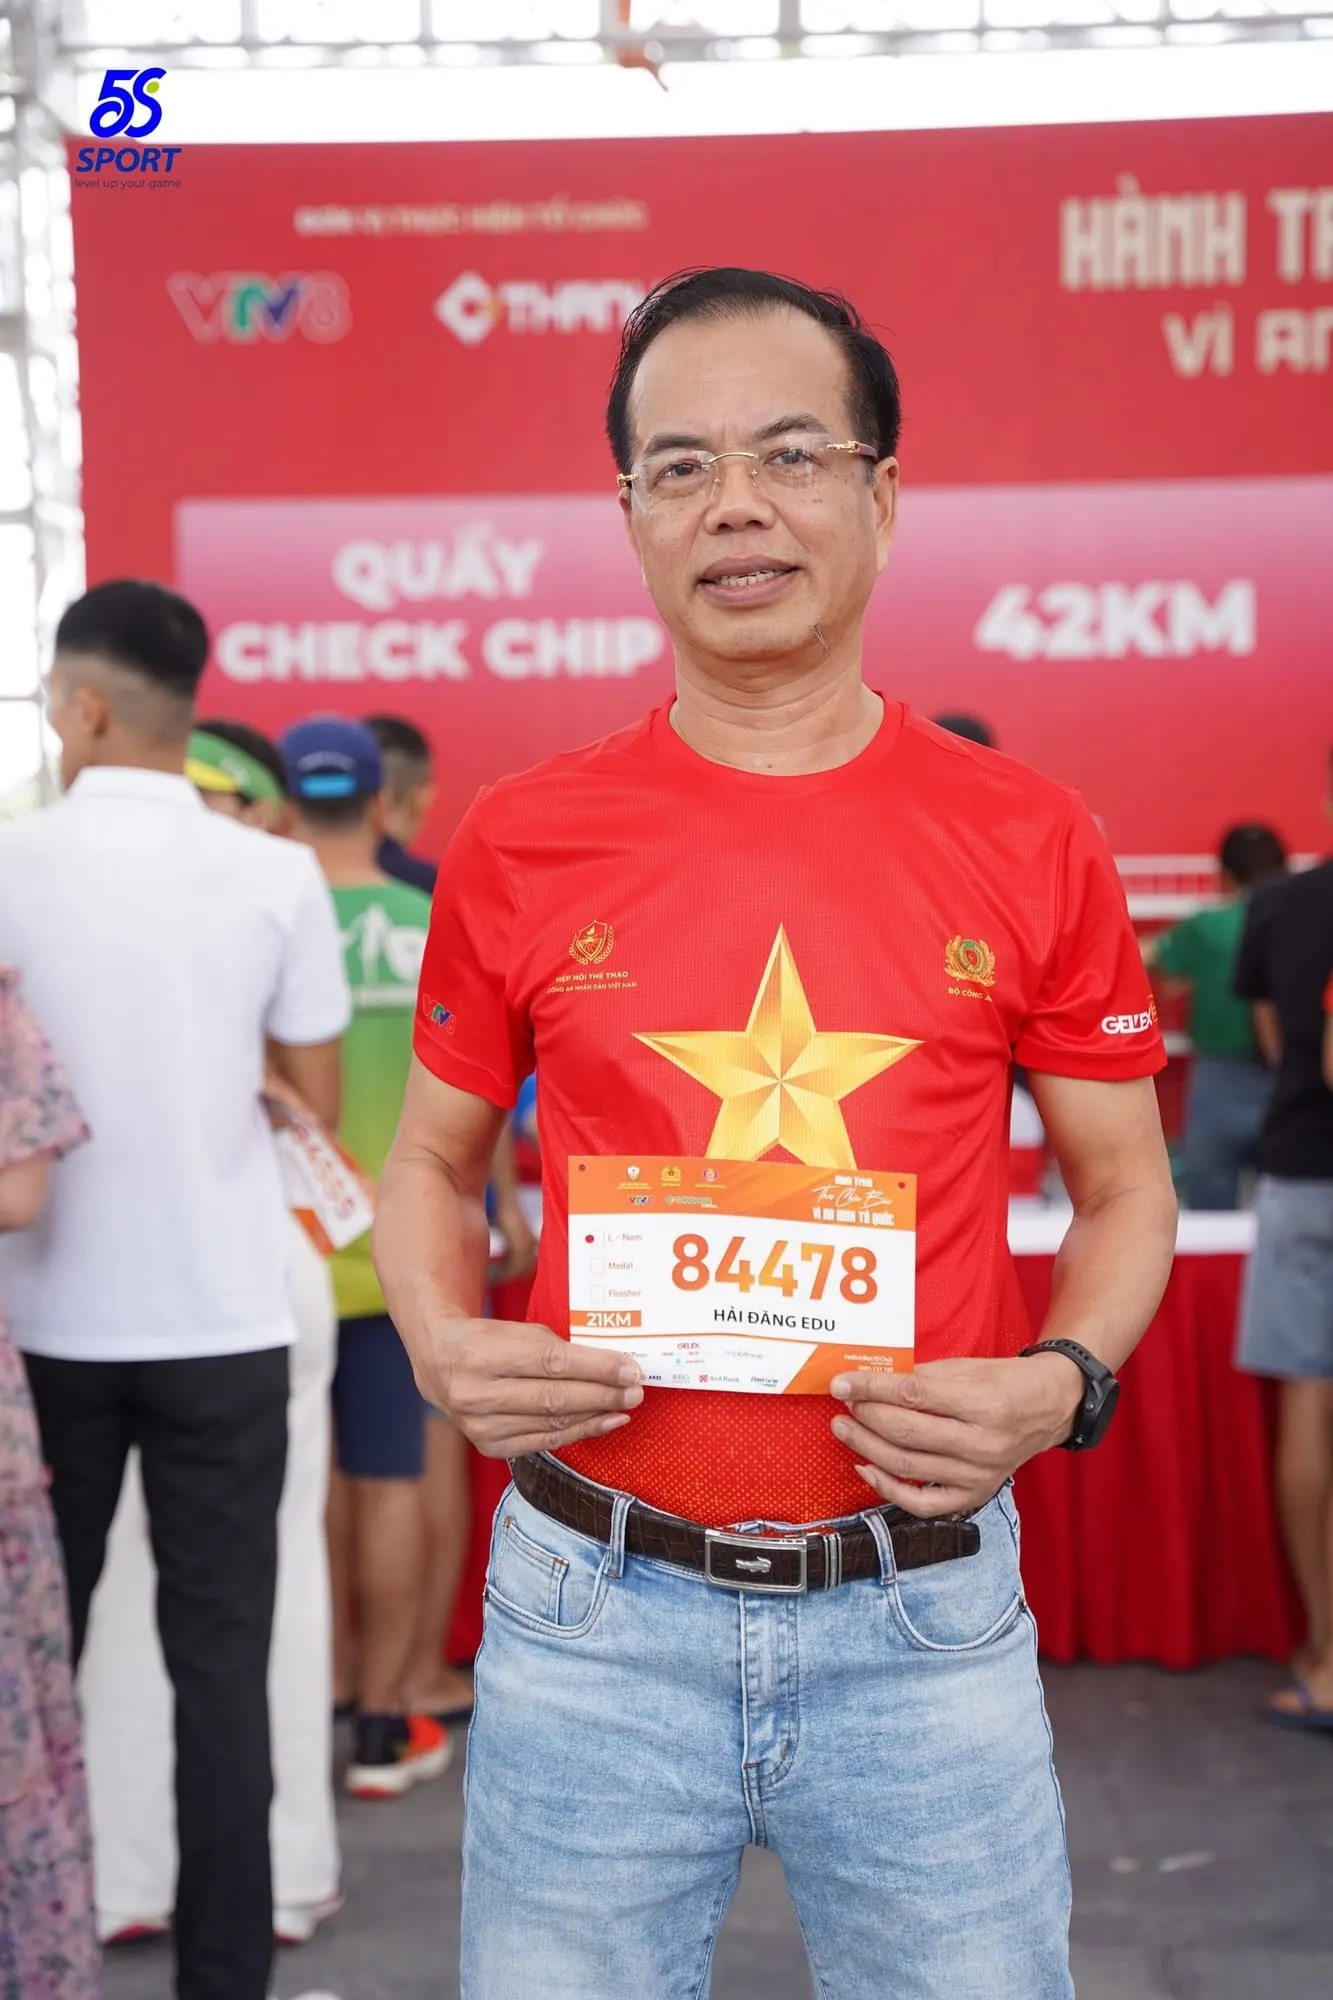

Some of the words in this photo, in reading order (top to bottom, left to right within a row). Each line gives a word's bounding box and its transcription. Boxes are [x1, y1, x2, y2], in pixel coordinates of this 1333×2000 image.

[167, 272, 351, 344] VTV8
[974, 580, 1256, 660] 42KM
[217, 622, 468, 682] CHECK
[483, 618, 664, 678] CHIP
[606, 971, 629, 979] THAO
[422, 992, 457, 1035] VTV8
[622, 1233, 643, 1241] Nam
[608, 1262, 634, 1271] Medal
[671, 1233, 878, 1304] 84478
[608, 1289, 642, 1299] Finisher
[586, 1312, 632, 1328] 21KM
[713, 1306, 743, 1323] HẢI
[747, 1310, 796, 1329] ĐĂNG
[801, 1316, 836, 1331] EDU
